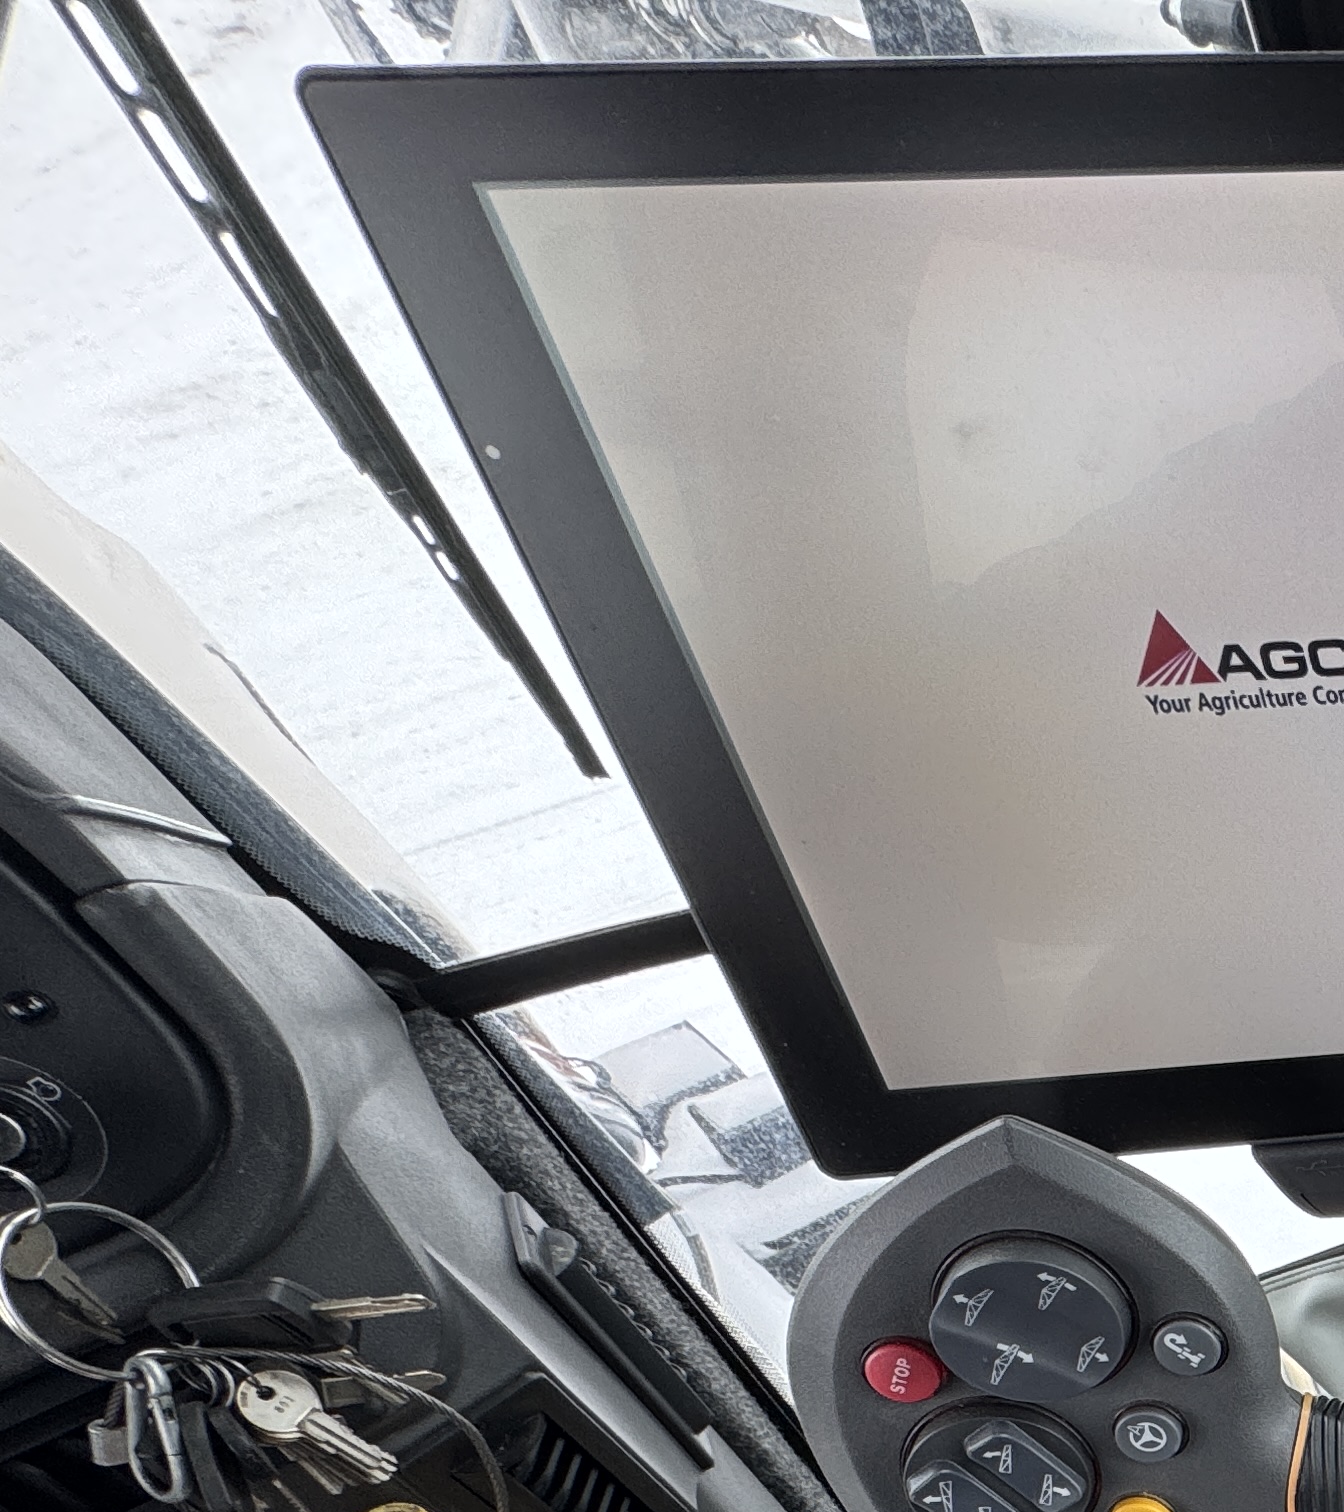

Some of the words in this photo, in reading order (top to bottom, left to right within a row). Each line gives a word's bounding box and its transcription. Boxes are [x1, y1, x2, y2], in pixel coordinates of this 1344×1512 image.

[1145, 694, 1191, 715] Your
[1198, 687, 1307, 716] Agriculture
[889, 1357, 911, 1395] STOP
